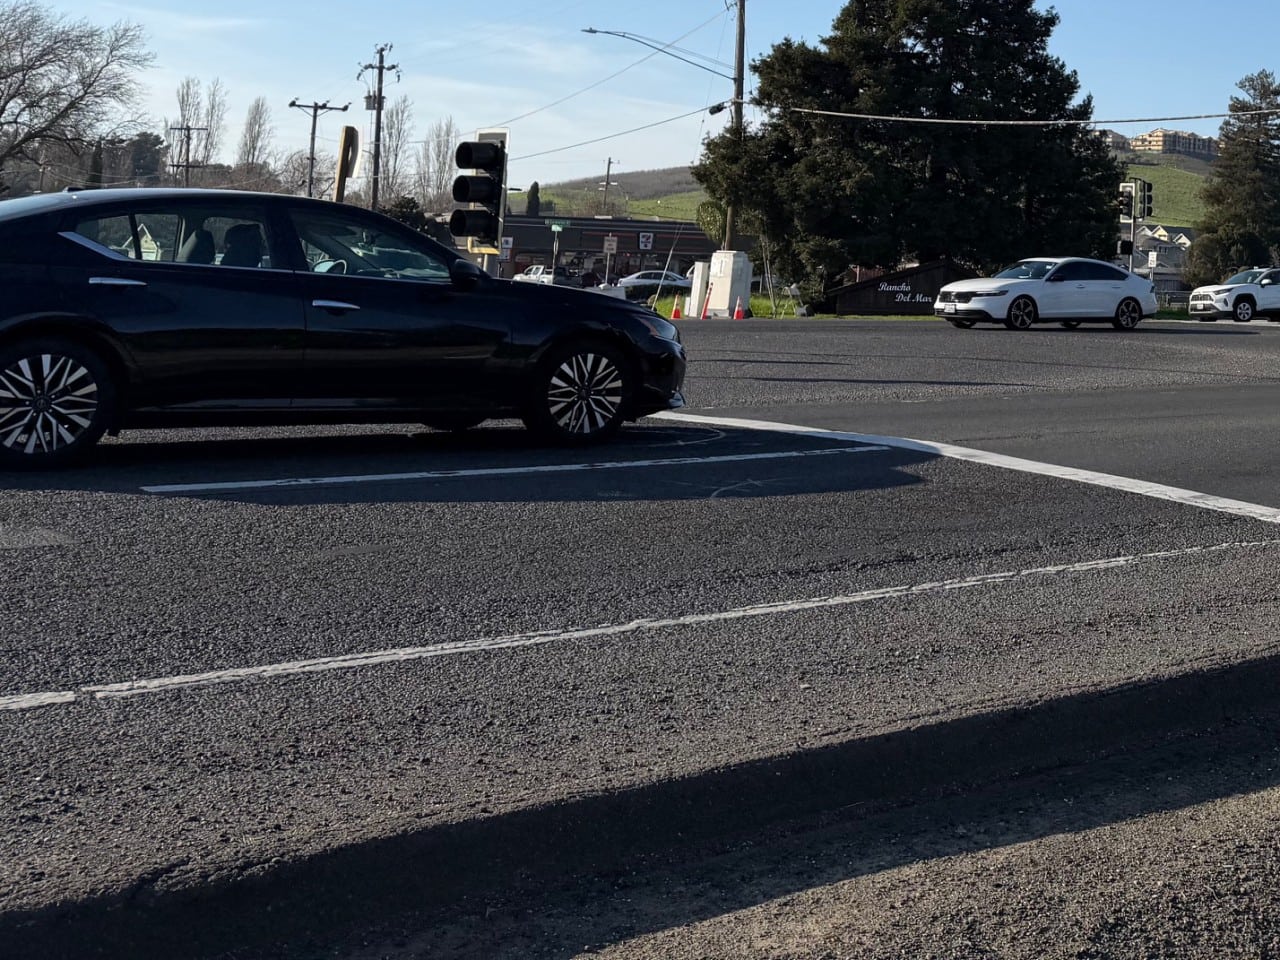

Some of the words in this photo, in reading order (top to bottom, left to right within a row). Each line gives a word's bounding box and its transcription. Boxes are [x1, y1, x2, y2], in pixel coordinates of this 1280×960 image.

[878, 281, 911, 291] Rancho
[895, 292, 911, 302] Del
[911, 293, 932, 302] Mar
